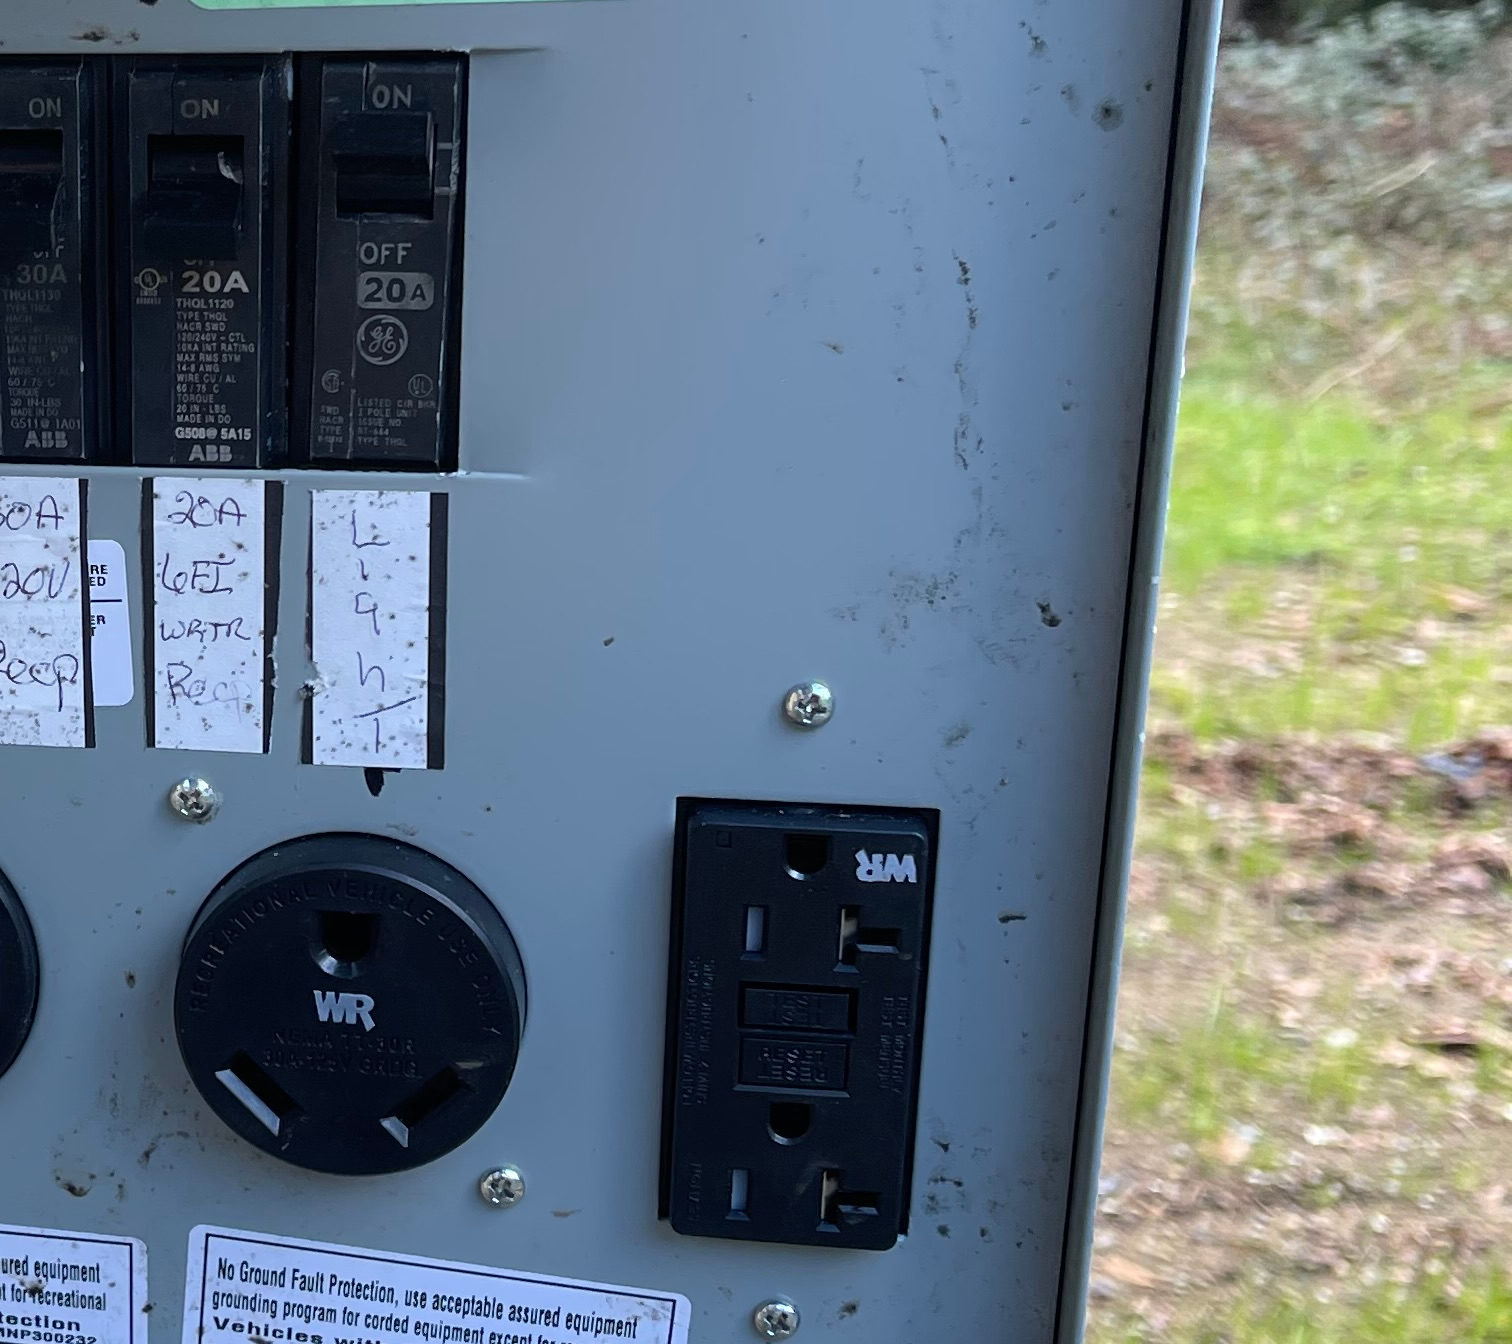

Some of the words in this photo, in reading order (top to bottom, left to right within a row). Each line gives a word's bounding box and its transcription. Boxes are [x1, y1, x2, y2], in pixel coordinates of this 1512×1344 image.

[28, 97, 62, 120] ON
[180, 98, 220, 120] ON
[371, 84, 413, 109] ON
[358, 241, 414, 265] OFF
[16, 263, 69, 285] 30A
[181, 269, 251, 294] 20A
[364, 277, 426, 304] 20A
[24, 430, 69, 449] ABB
[188, 444, 233, 463] ABB
[167, 490, 248, 528] 20A
[854, 849, 918, 884] WR
[312, 989, 376, 1033] WR
[33, 1257, 101, 1284] equipment
[213, 1316, 323, 1344] Vehicles
